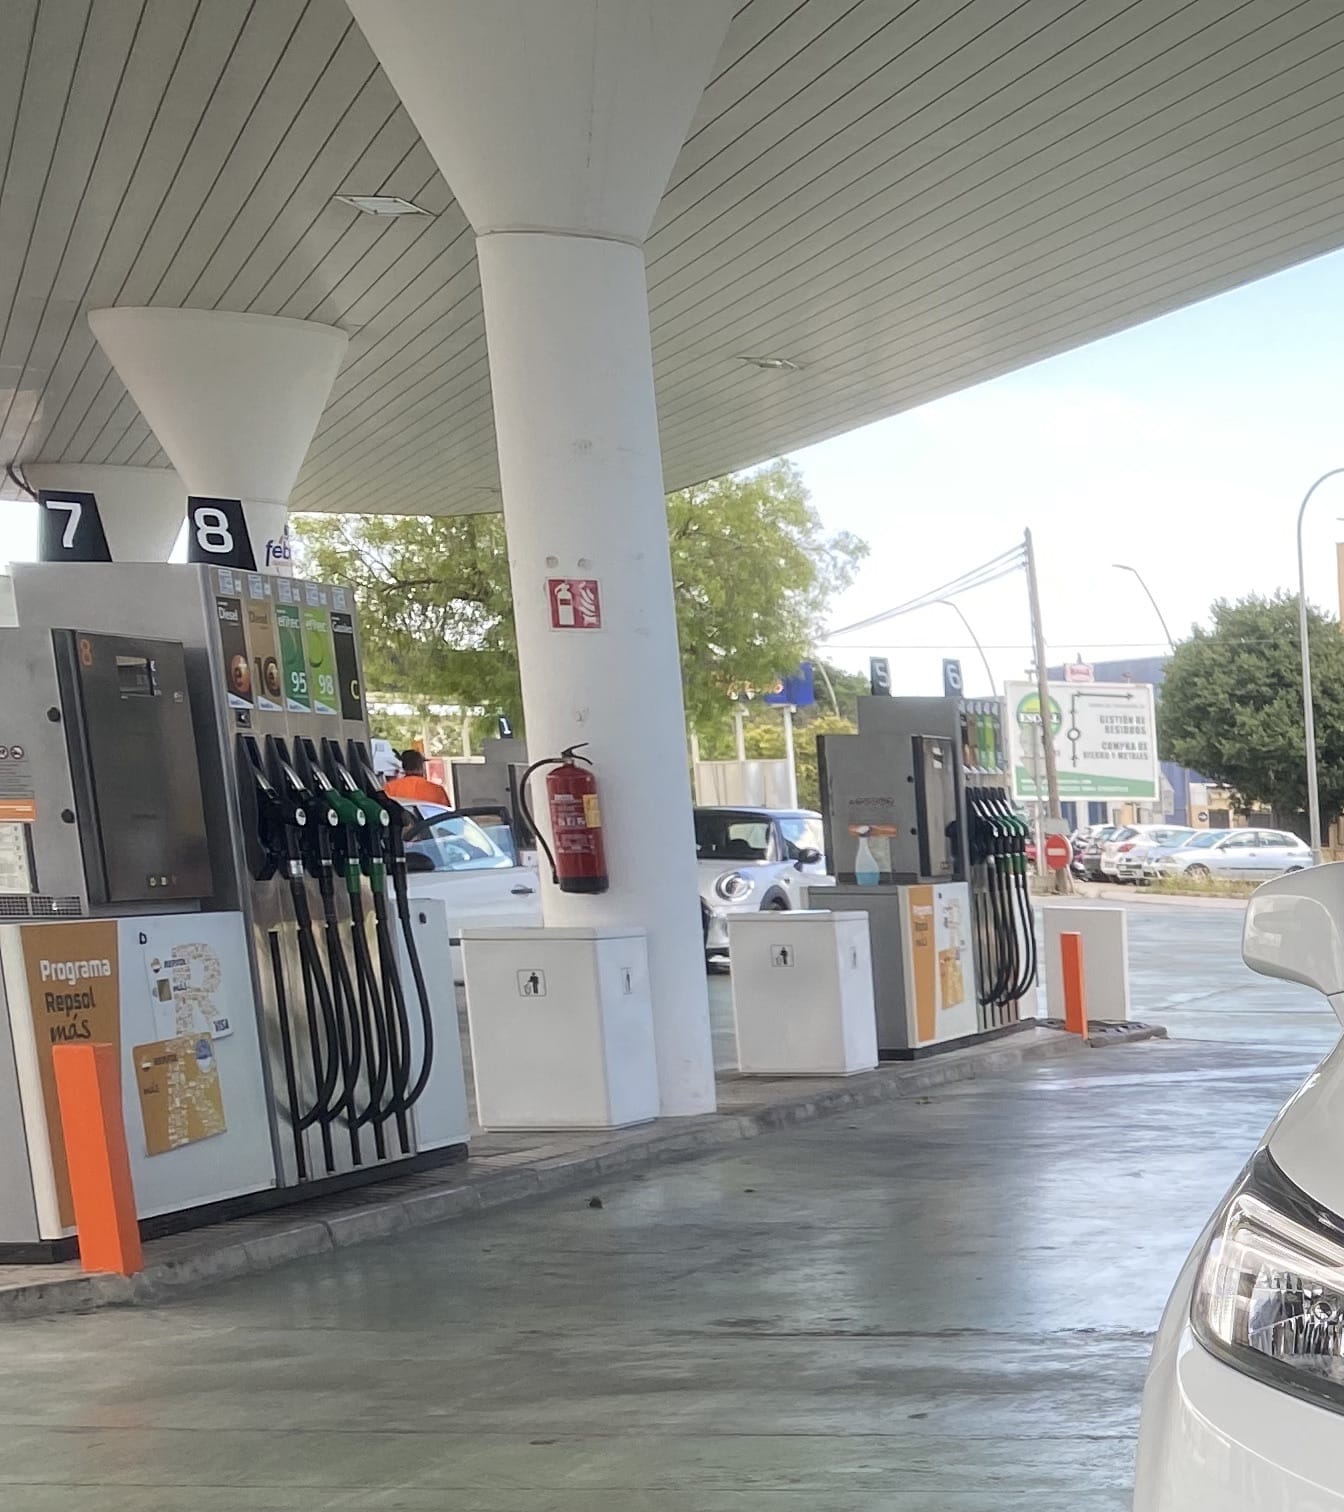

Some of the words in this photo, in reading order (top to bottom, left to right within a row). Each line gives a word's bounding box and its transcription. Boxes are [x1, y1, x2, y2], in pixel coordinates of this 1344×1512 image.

[46, 501, 82, 548] 7
[194, 507, 234, 553] 8
[80, 639, 93, 667] 8
[291, 671, 307, 694] 95
[318, 674, 334, 695] 98
[873, 662, 890, 688] 5
[946, 663, 961, 690] 6
[350, 680, 361, 700] C
[499, 717, 512, 735] 1
[139, 932, 147, 945] D
[39, 958, 112, 986] Programa
[44, 987, 96, 1019] Repsol
[50, 1013, 91, 1043] más
[213, 1018, 229, 1032] VISA
